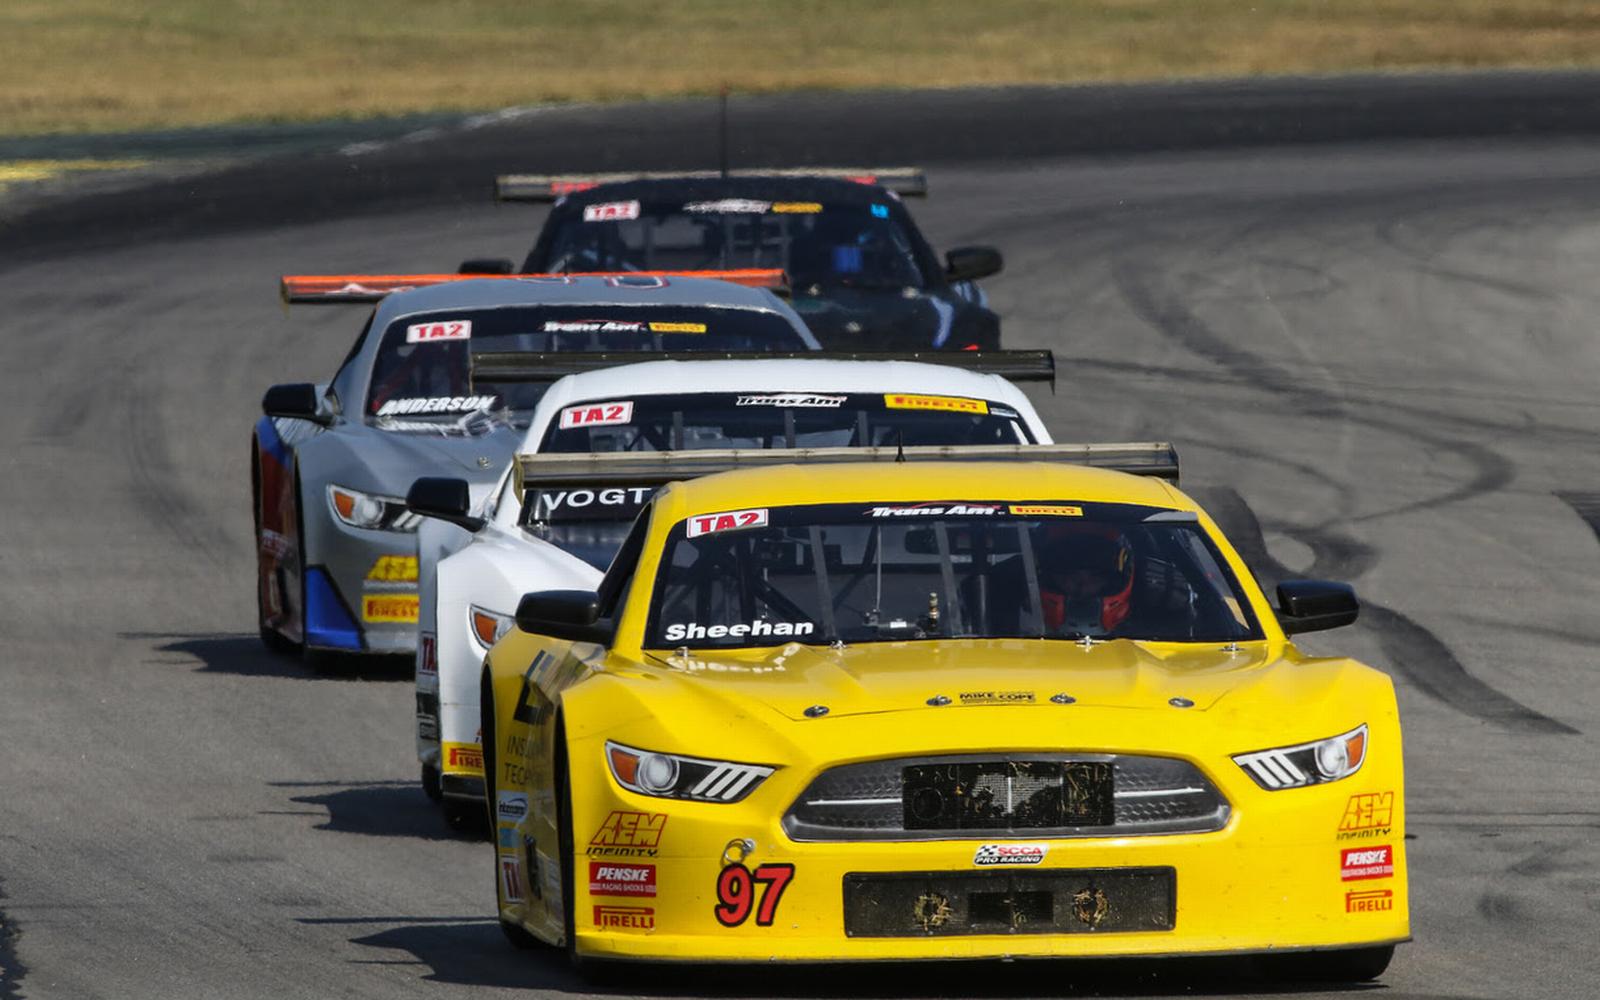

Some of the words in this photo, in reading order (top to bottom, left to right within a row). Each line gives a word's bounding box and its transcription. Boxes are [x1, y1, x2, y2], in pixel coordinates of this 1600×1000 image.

[415, 323, 464, 339] TA2
[376, 396, 498, 416] ANDERSON
[895, 396, 978, 410] PIRELLI
[569, 405, 623, 424] TA2
[541, 487, 652, 511] VOGT
[872, 507, 943, 517] Trans
[944, 505, 996, 516] Am
[1015, 507, 1076, 515] PIRELLI
[695, 511, 759, 534] TA2
[664, 620, 815, 641] Sheehan
[1338, 791, 1394, 831] AEM
[590, 810, 669, 847] AEM
[998, 847, 1042, 856] SCCA
[1345, 849, 1387, 867] PENSKE
[596, 867, 650, 881] PENSKE
[714, 863, 795, 928] 97
[1345, 889, 1393, 913] PIRELLI
[593, 904, 656, 928] PIRELLI
